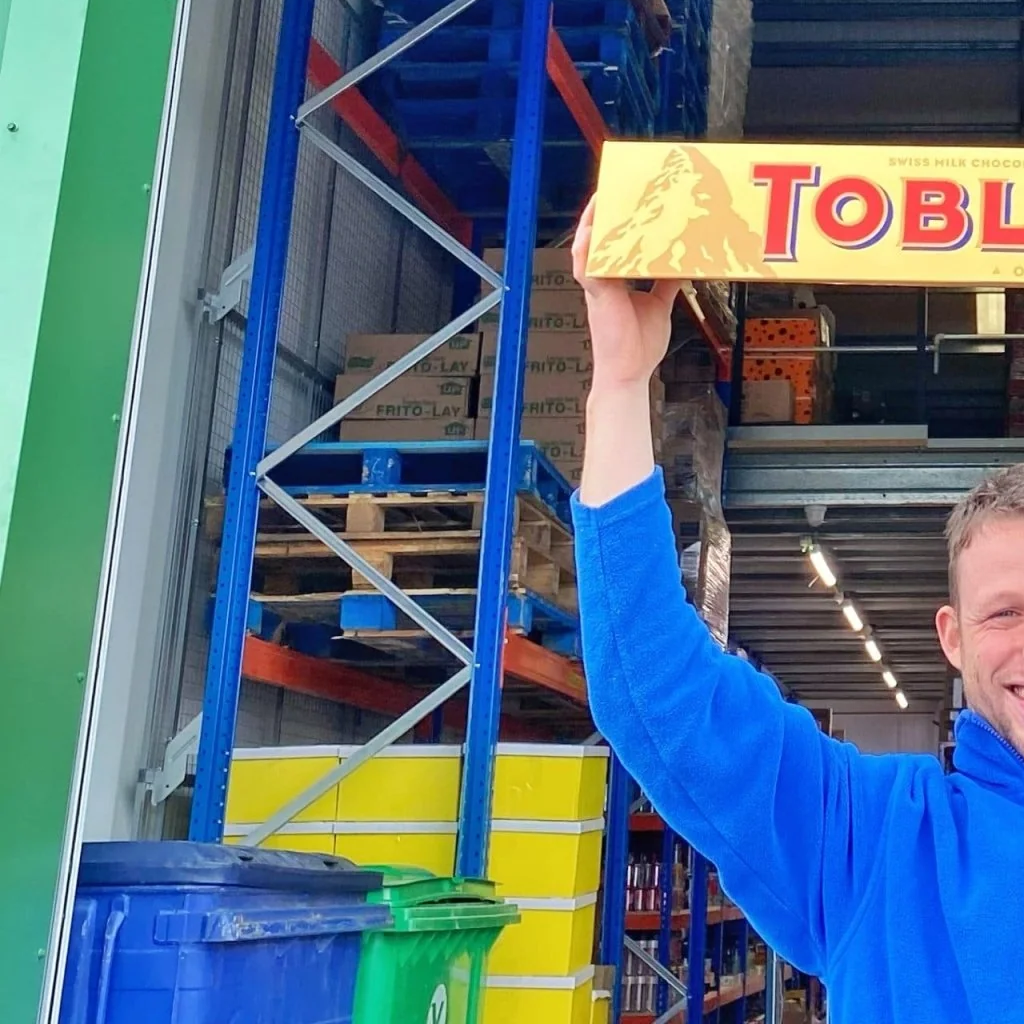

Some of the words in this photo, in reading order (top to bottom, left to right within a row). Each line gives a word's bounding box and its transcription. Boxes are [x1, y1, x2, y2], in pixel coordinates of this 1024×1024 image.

[888, 157, 930, 167] SWISS
[934, 158, 967, 168] MILK
[376, 404, 461, 417] FRITO-LAY
